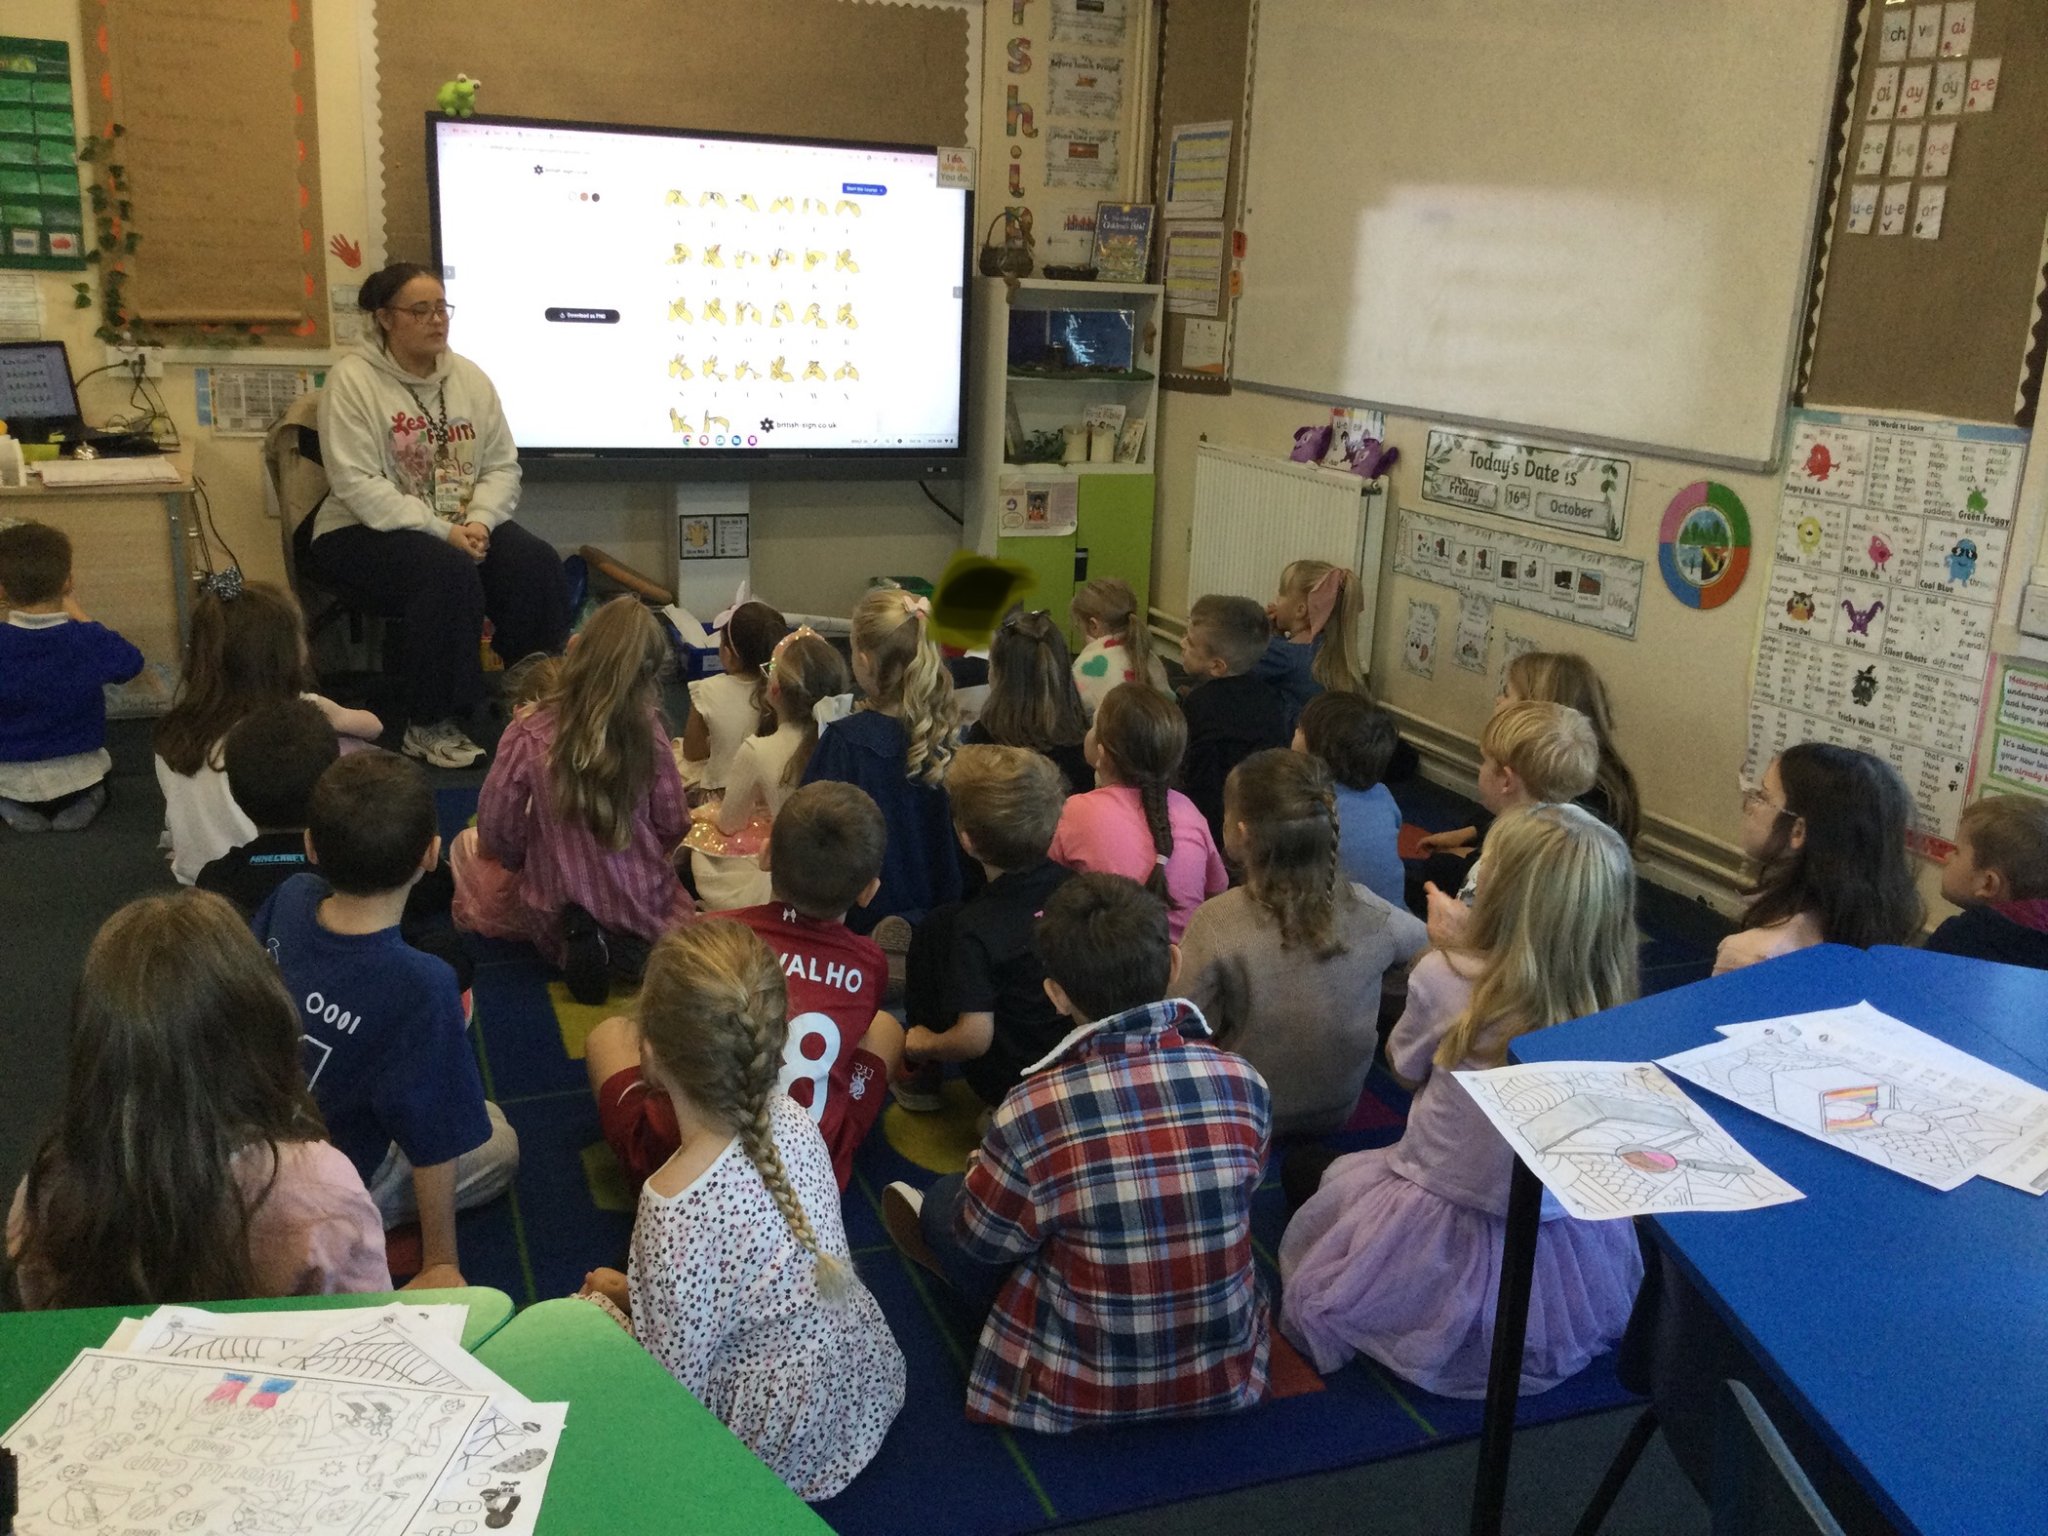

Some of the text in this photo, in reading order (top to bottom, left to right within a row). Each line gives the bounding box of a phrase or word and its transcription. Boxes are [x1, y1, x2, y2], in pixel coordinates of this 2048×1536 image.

[1970, 78, 1996, 91] a-e
[1906, 86, 1924, 102] ay
[941, 173, 956, 182] You
[1885, 204, 1905, 216] u-e
[391, 410, 427, 436] Les
[1907, 423, 1925, 432] Learn
[427, 423, 476, 444] FUITS
[1469, 450, 1577, 487] Today's Date is
[1450, 483, 1594, 519] Friday 16th October
[1958, 510, 2010, 528] Green Froggy
[1776, 552, 1795, 562] Yellow
[1843, 566, 1880, 580] Miss Oh No
[1920, 579, 1954, 593] Cool Blue
[1778, 622, 1811, 636] Brown Owl
[1884, 646, 1927, 663] Silent Ghosts
[2005, 699, 2019, 707] and
[2021, 702, 2038, 712] how
[1838, 711, 1875, 729] Tricky Witch
[2003, 710, 2018, 721] help
[2021, 715, 2035, 724] you
[2002, 738, 2015, 748] It's
[2017, 742, 2038, 754] about
[2001, 751, 2018, 761] your
[1999, 763, 2013, 773] you
[2014, 766, 2042, 782] already
[782, 1012, 841, 1125] 8
[123, 1451, 296, 1491] World Cup
